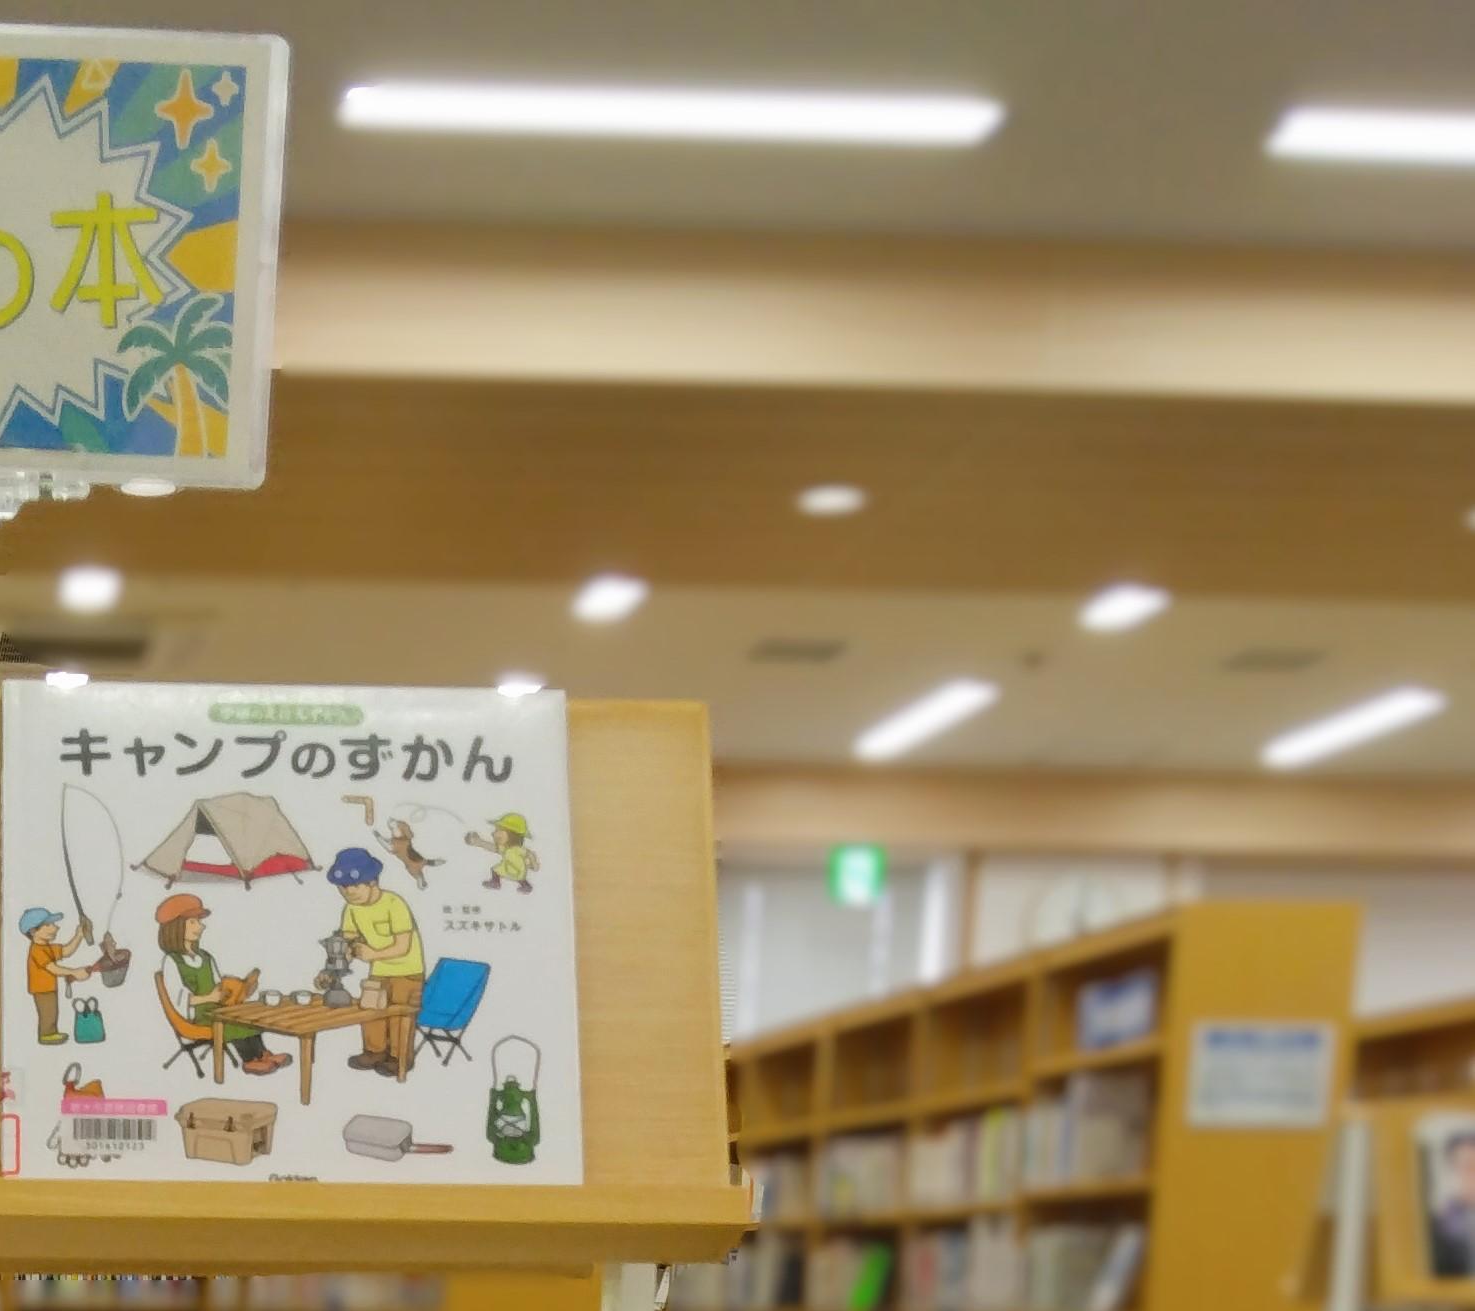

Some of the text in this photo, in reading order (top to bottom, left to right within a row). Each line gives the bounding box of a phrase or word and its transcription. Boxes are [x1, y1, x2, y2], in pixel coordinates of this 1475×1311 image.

[59, 728, 514, 783] キャンプのずかん
